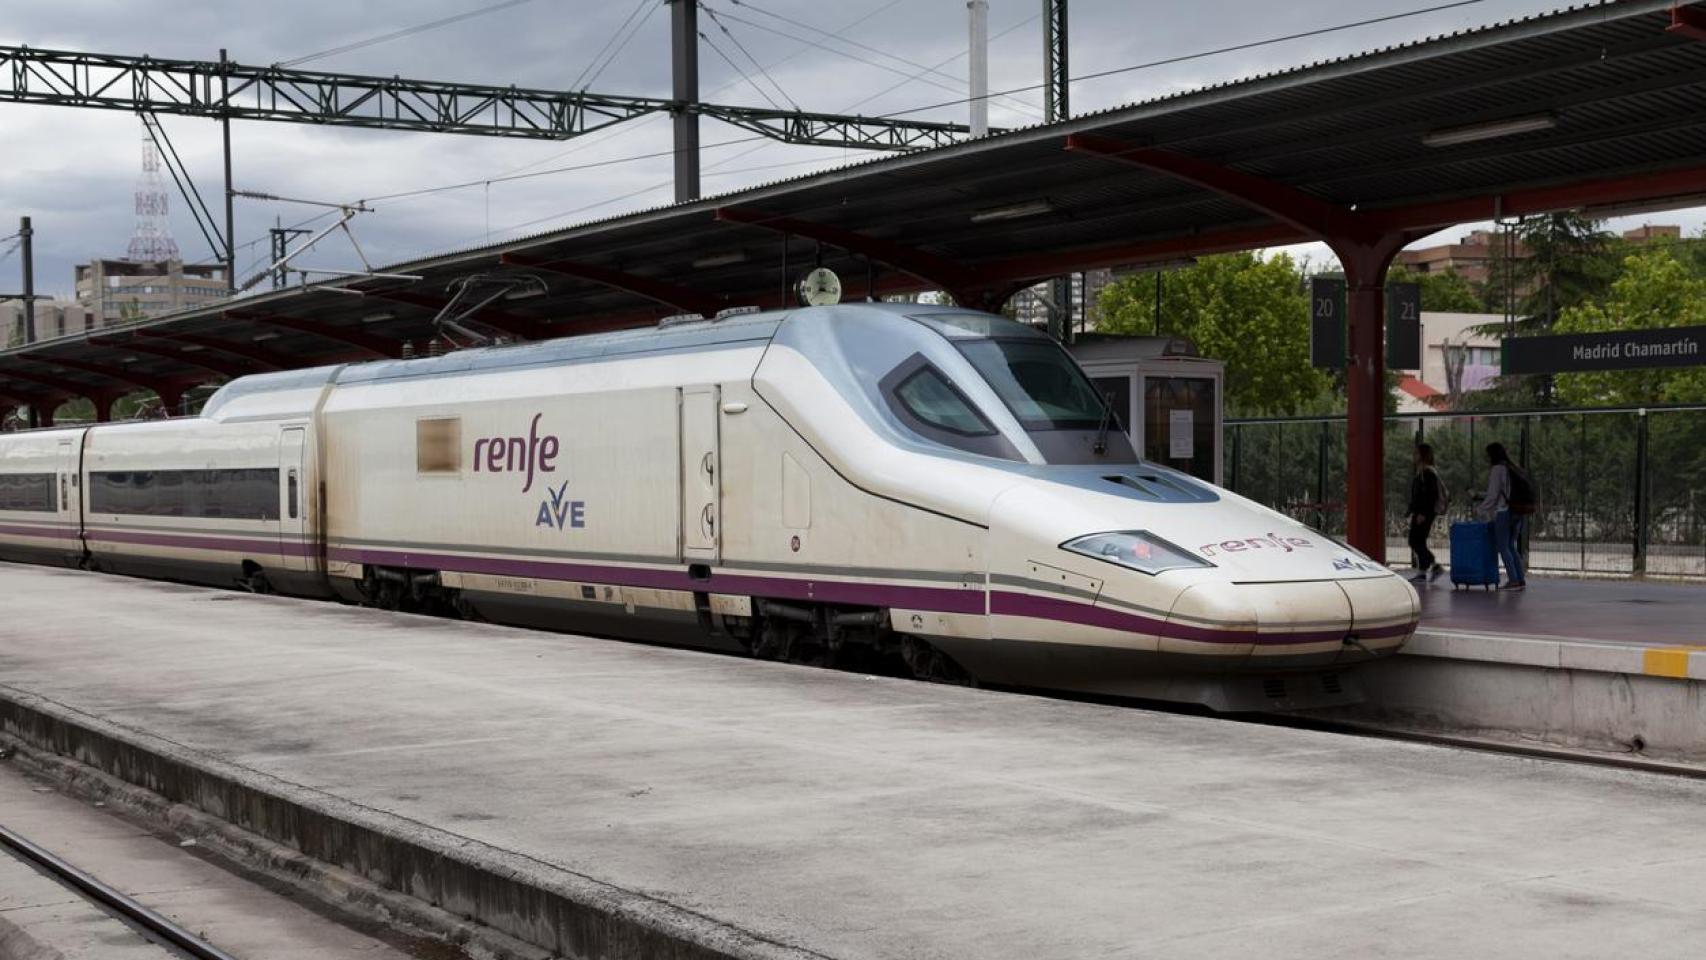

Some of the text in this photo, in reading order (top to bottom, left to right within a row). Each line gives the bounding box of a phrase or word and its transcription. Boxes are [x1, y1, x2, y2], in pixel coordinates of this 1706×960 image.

[1316, 299, 1333, 317] 20
[1401, 302, 1416, 320] 21
[1573, 338, 1698, 360] Madrid Chamartín
[473, 412, 559, 493] renfe
[535, 480, 585, 531] AVE
[1200, 532, 1314, 557] renfe
